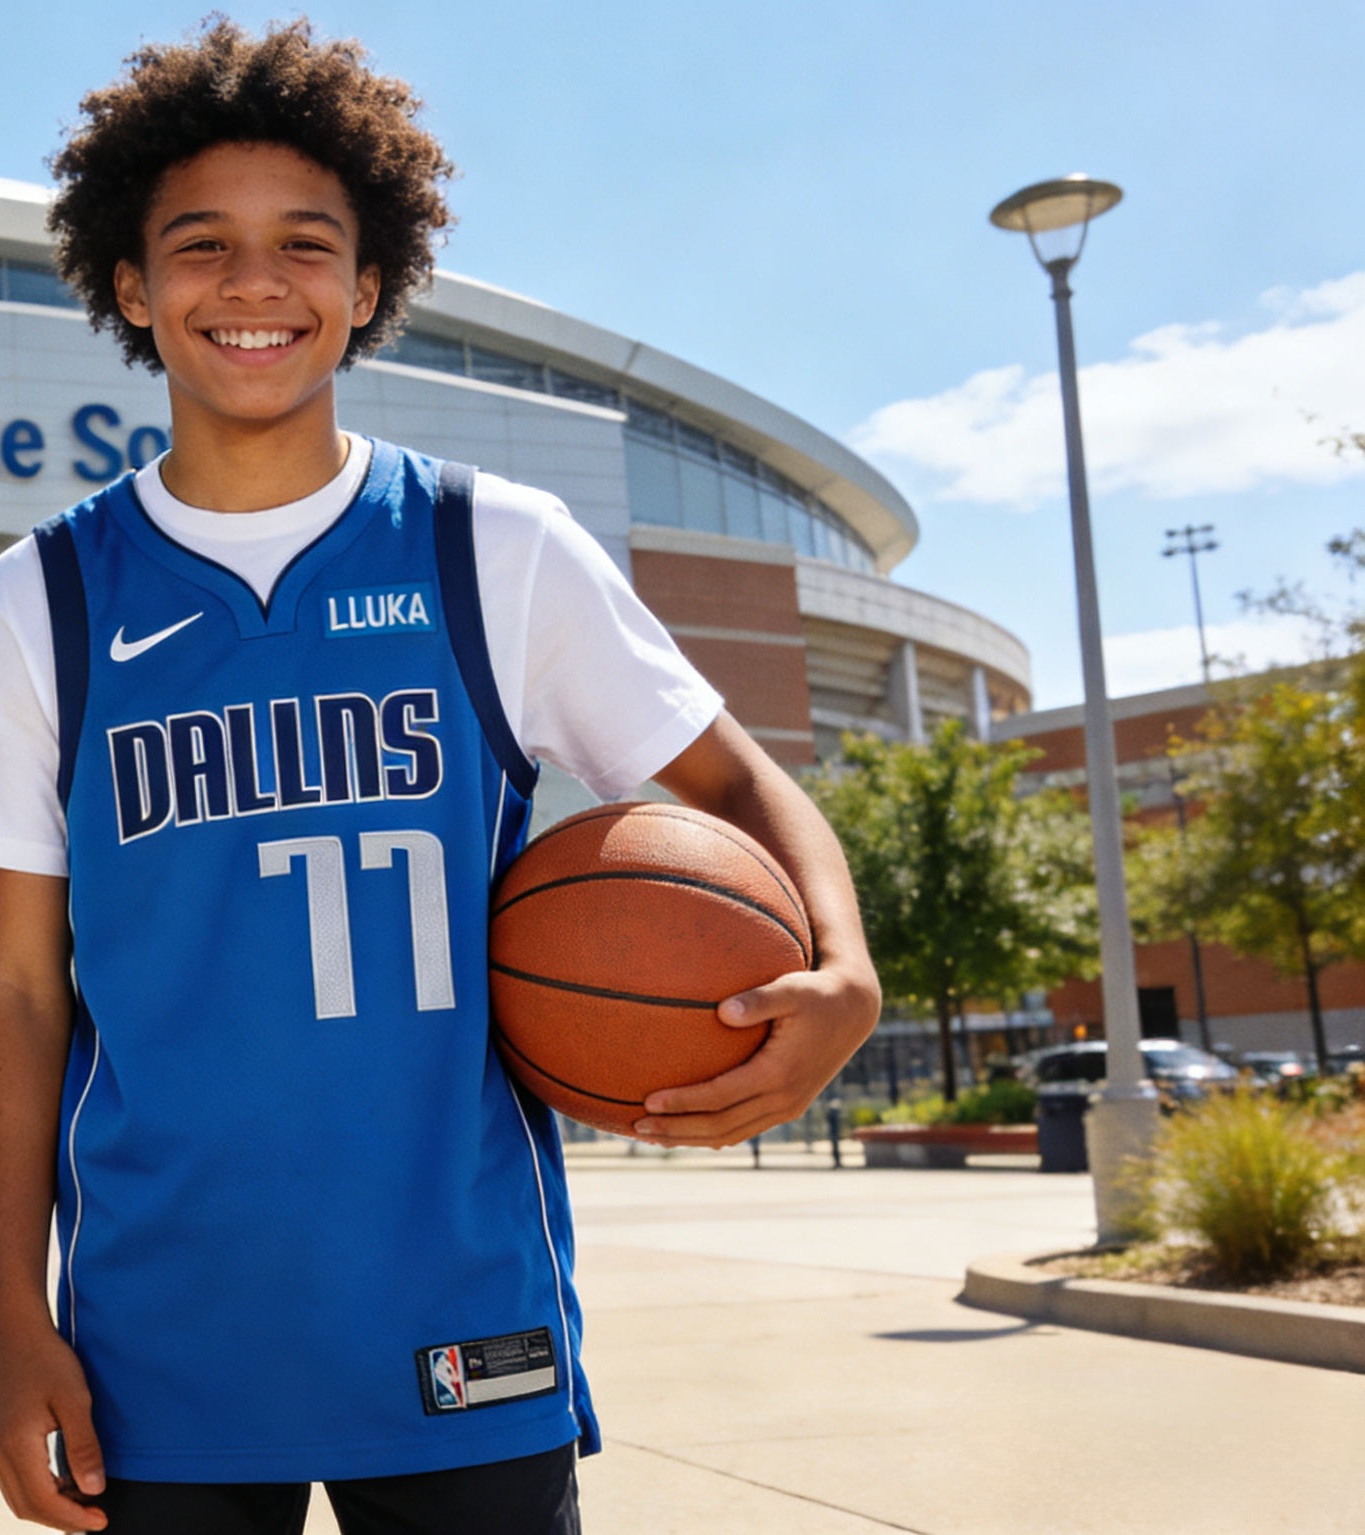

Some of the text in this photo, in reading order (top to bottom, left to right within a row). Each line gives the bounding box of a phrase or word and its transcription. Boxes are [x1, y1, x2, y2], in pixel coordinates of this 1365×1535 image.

[72, 403, 172, 483] So
[328, 592, 430, 631] LLUKA
[257, 829, 456, 1021] 77
